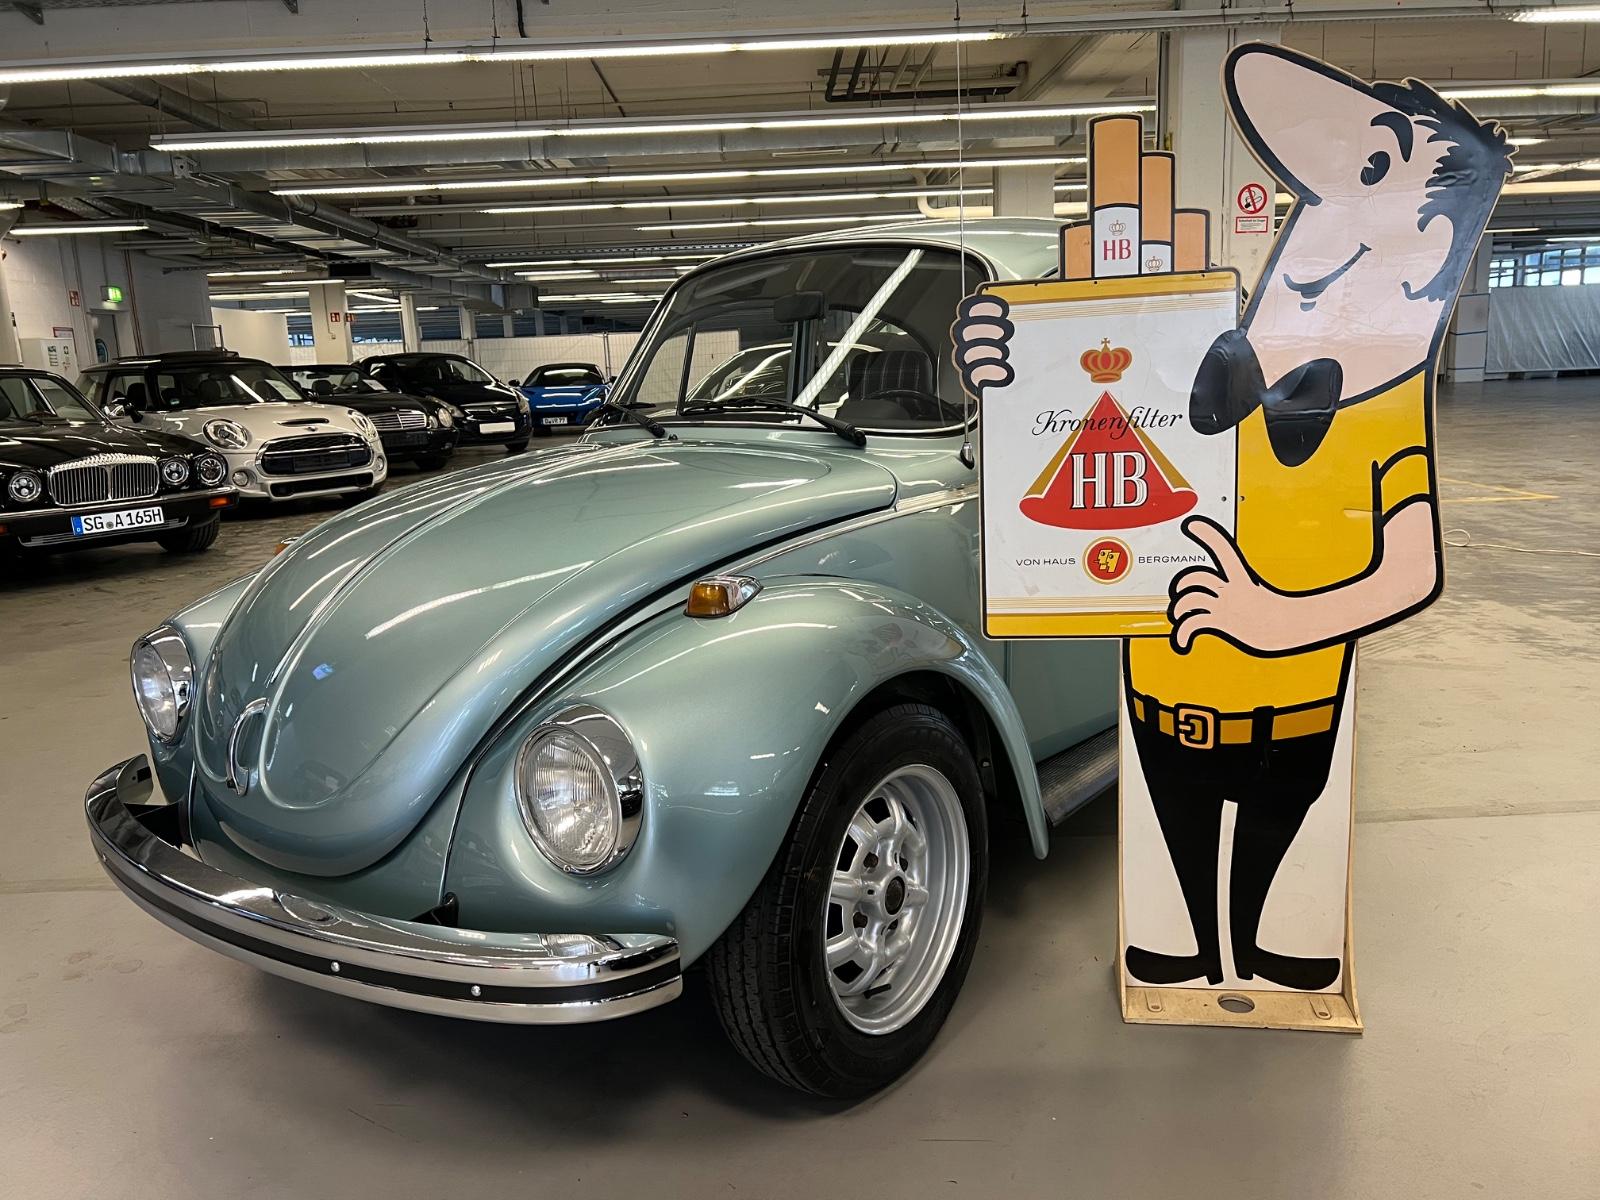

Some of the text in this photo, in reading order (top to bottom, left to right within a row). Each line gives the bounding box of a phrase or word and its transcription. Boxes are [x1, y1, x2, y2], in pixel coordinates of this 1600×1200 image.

[1103, 238, 1132, 261] HB
[1031, 406, 1183, 440] Kronenfilter
[1070, 451, 1149, 509] HB
[83, 508, 163, 532] SG A 165H
[1016, 554, 1207, 567] VON HAUS BERGMANN
